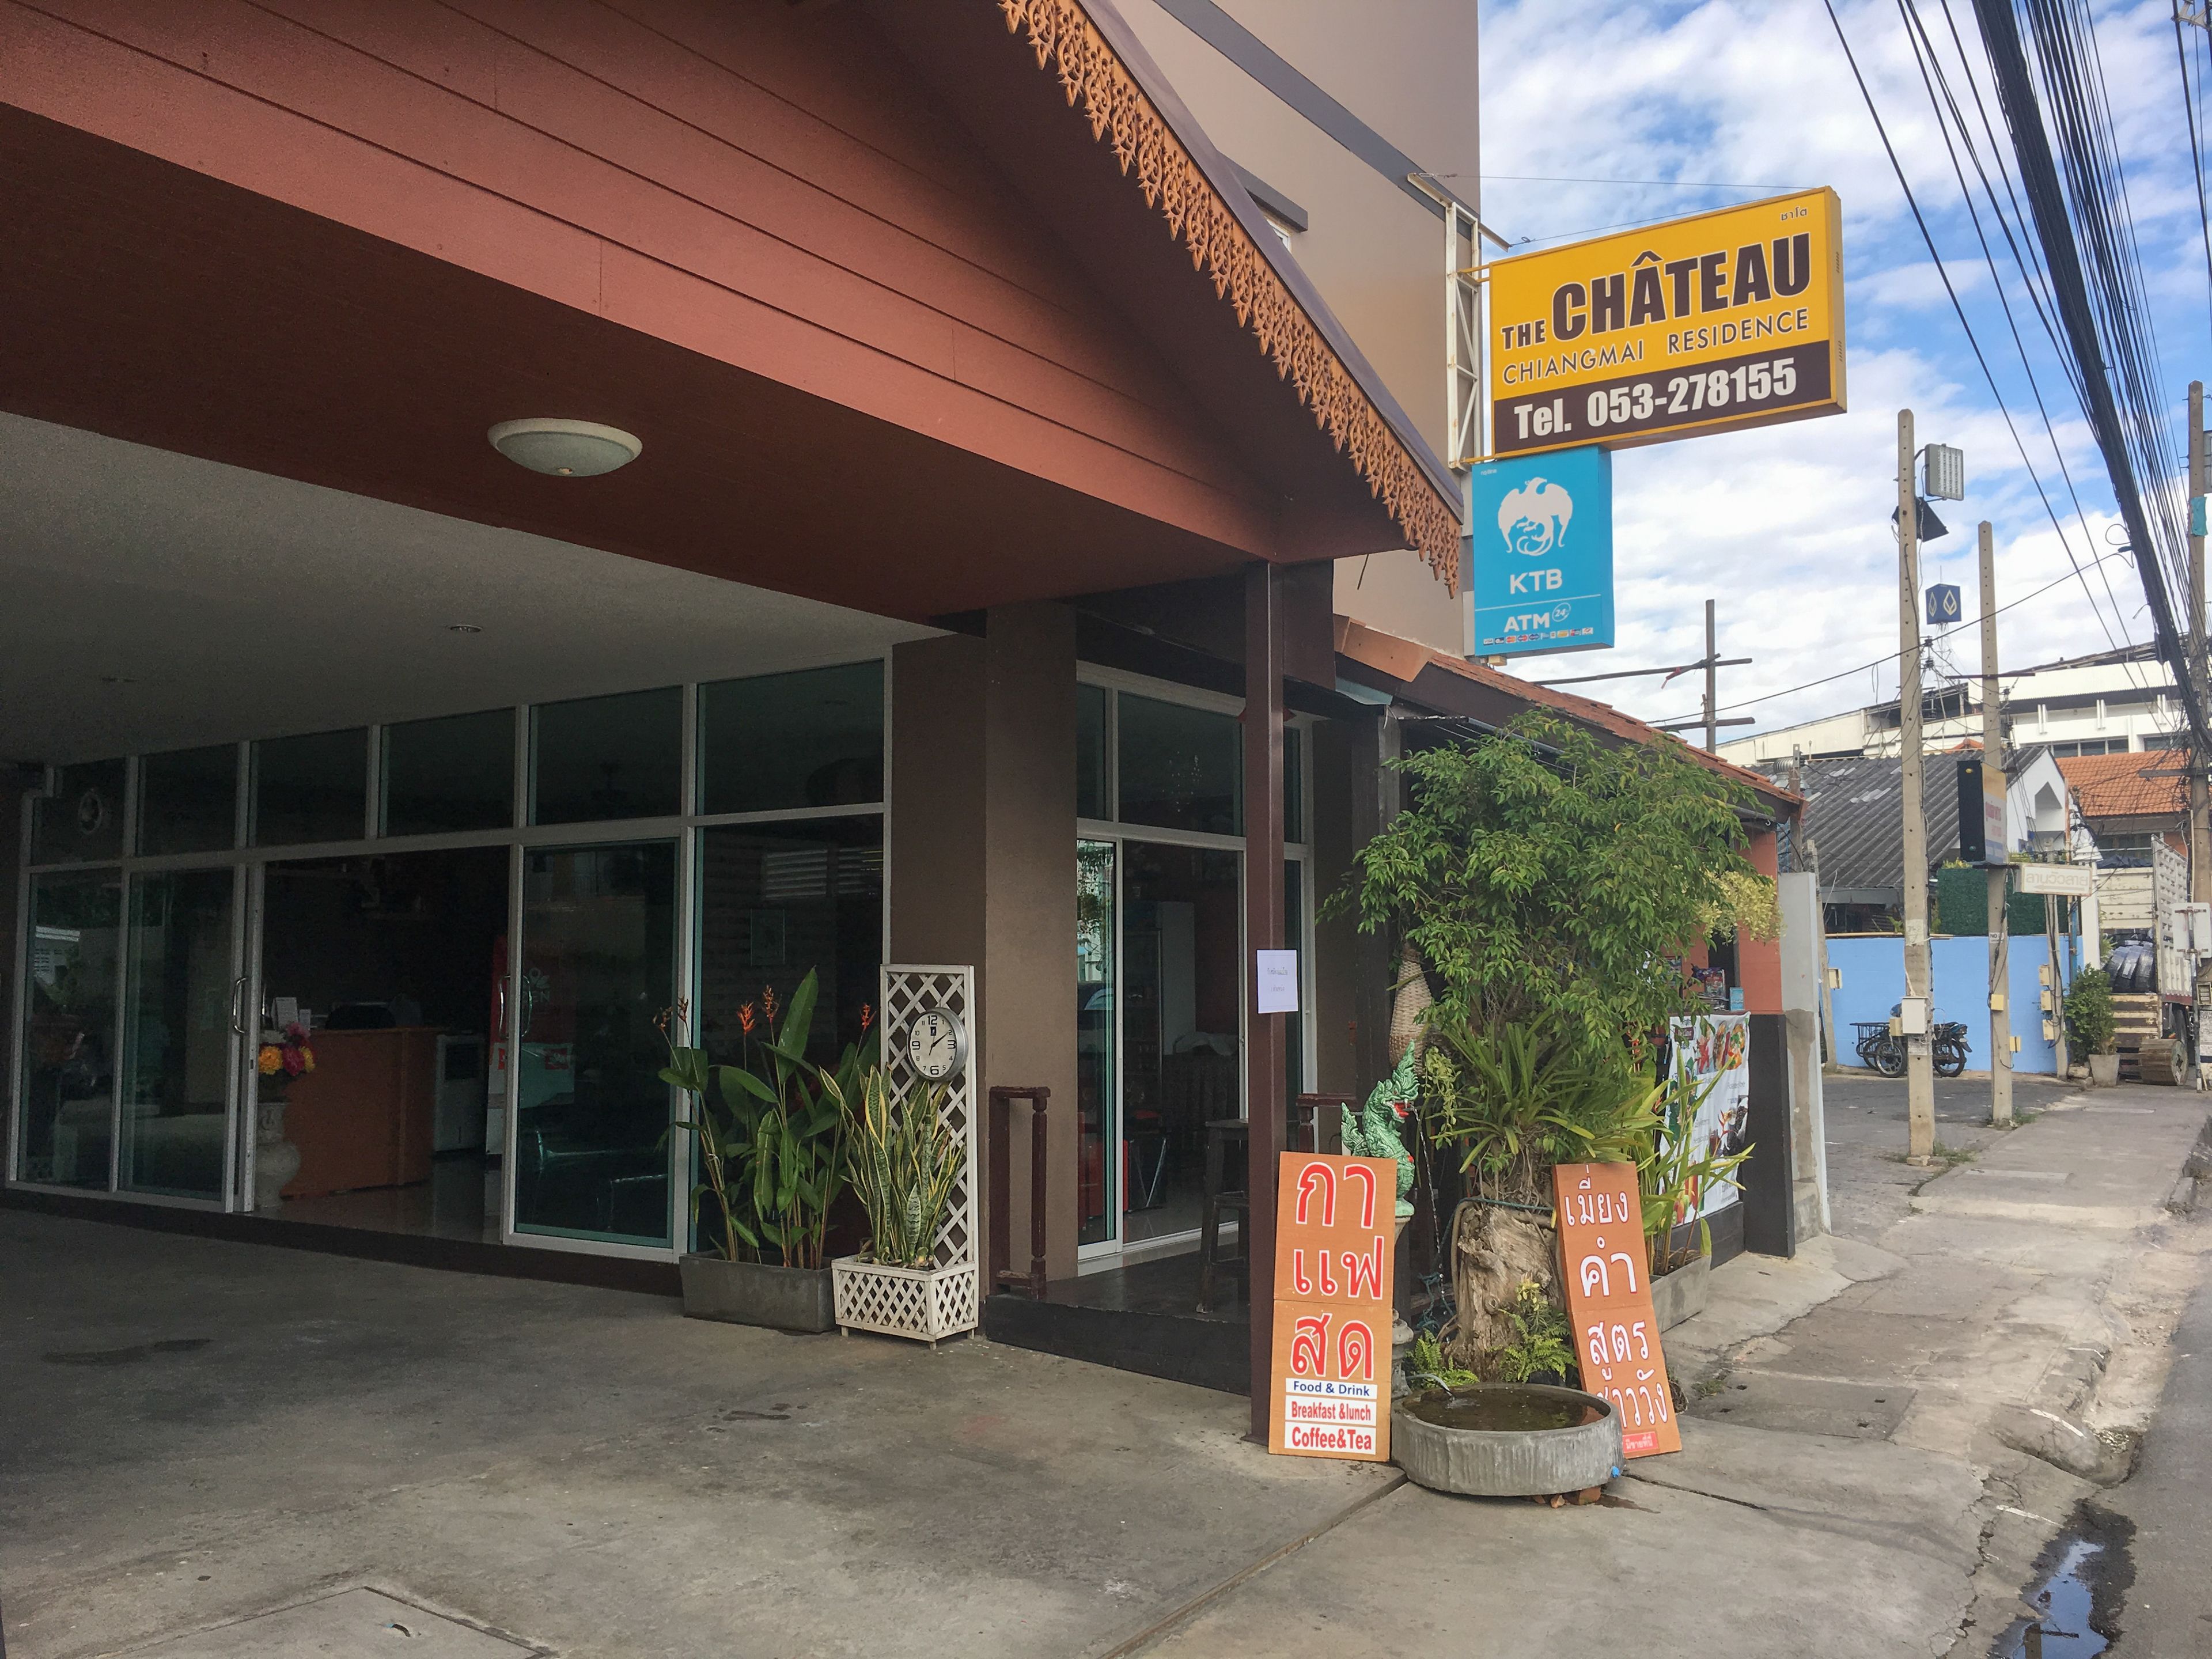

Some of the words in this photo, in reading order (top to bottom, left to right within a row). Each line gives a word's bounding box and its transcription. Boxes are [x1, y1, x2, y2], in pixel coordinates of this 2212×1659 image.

[1501, 319, 1546, 351] THE
[1552, 232, 1811, 341] CHÂTEAU
[1502, 340, 1644, 385] CHIANGMAI
[1667, 308, 1809, 356] RESIDENCE
[1514, 398, 1571, 440] Tel.
[1587, 357, 1797, 427] 053-278155
[1509, 568, 1563, 594] KTB
[1503, 612, 1550, 633] ATM
[1554, 608, 1566, 618] 24
[927, 1015, 938, 1025] 12
[911, 1040, 921, 1050] 9
[947, 1040, 956, 1049] 3
[930, 1065, 939, 1075] 6
[1296, 1161, 1377, 1229] กา
[1564, 1163, 1629, 1227] เมี่ยง
[1293, 1236, 1384, 1300] แฟ
[1580, 1236, 1638, 1298] คำ
[1290, 1313, 1374, 1380] สด
[1588, 1320, 1649, 1381] สูตร
[1291, 1400, 1336, 1419] Breakfast
[1293, 1380, 1322, 1393] Food
[1325, 1382, 1335, 1393] &
[1339, 1384, 1370, 1396] Drink
[1292, 1426, 1372, 1450] Coffee&Tea
